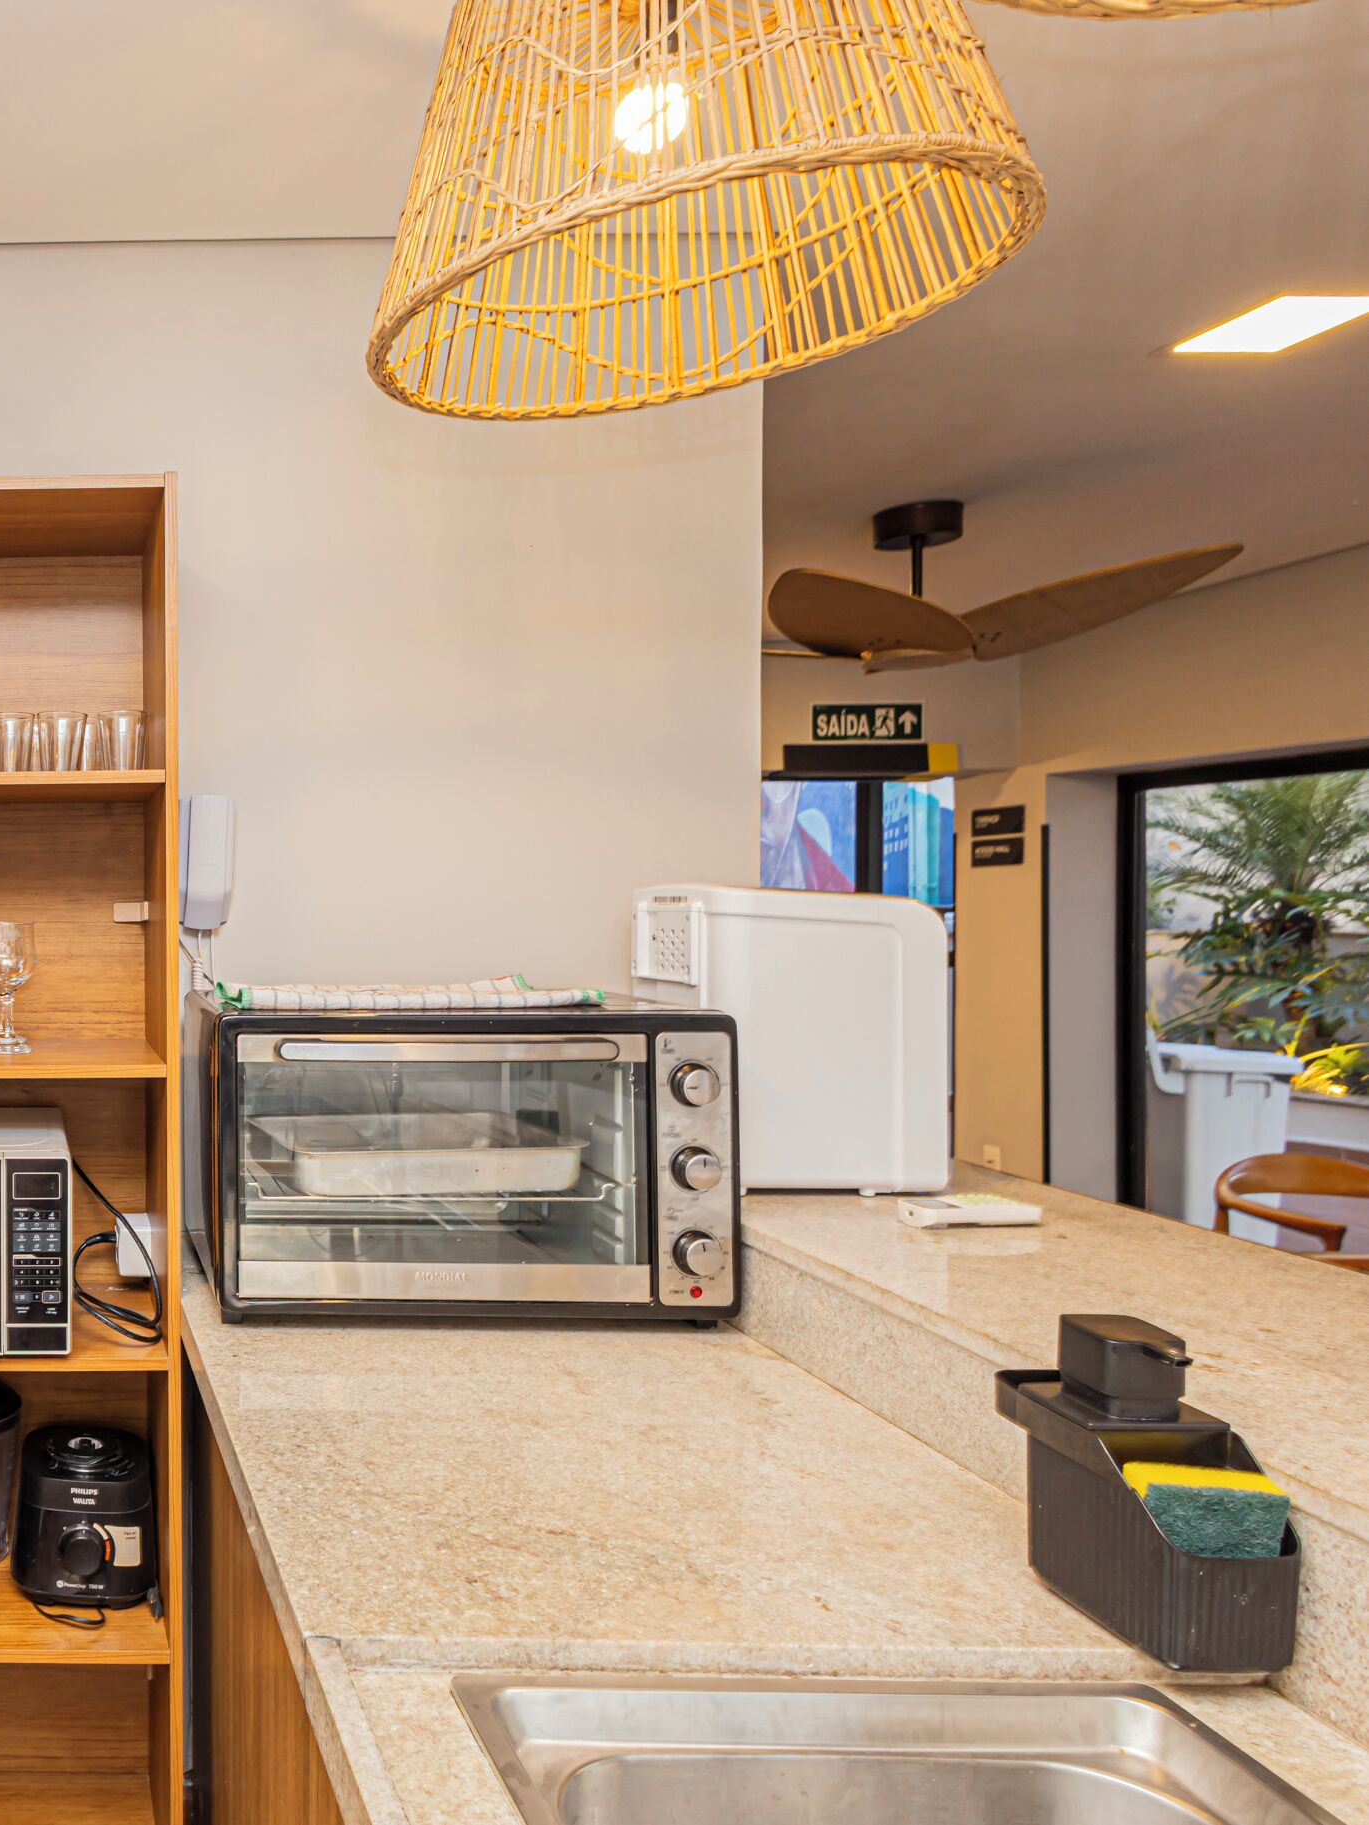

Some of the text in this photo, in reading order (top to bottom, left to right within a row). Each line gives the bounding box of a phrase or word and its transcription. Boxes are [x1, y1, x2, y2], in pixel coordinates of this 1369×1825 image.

[816, 708, 870, 738] SAÍDA
[414, 1271, 470, 1282] MONDIAL
[70, 1487, 99, 1496] PHILIPS
[72, 1497, 96, 1505] WALITA
